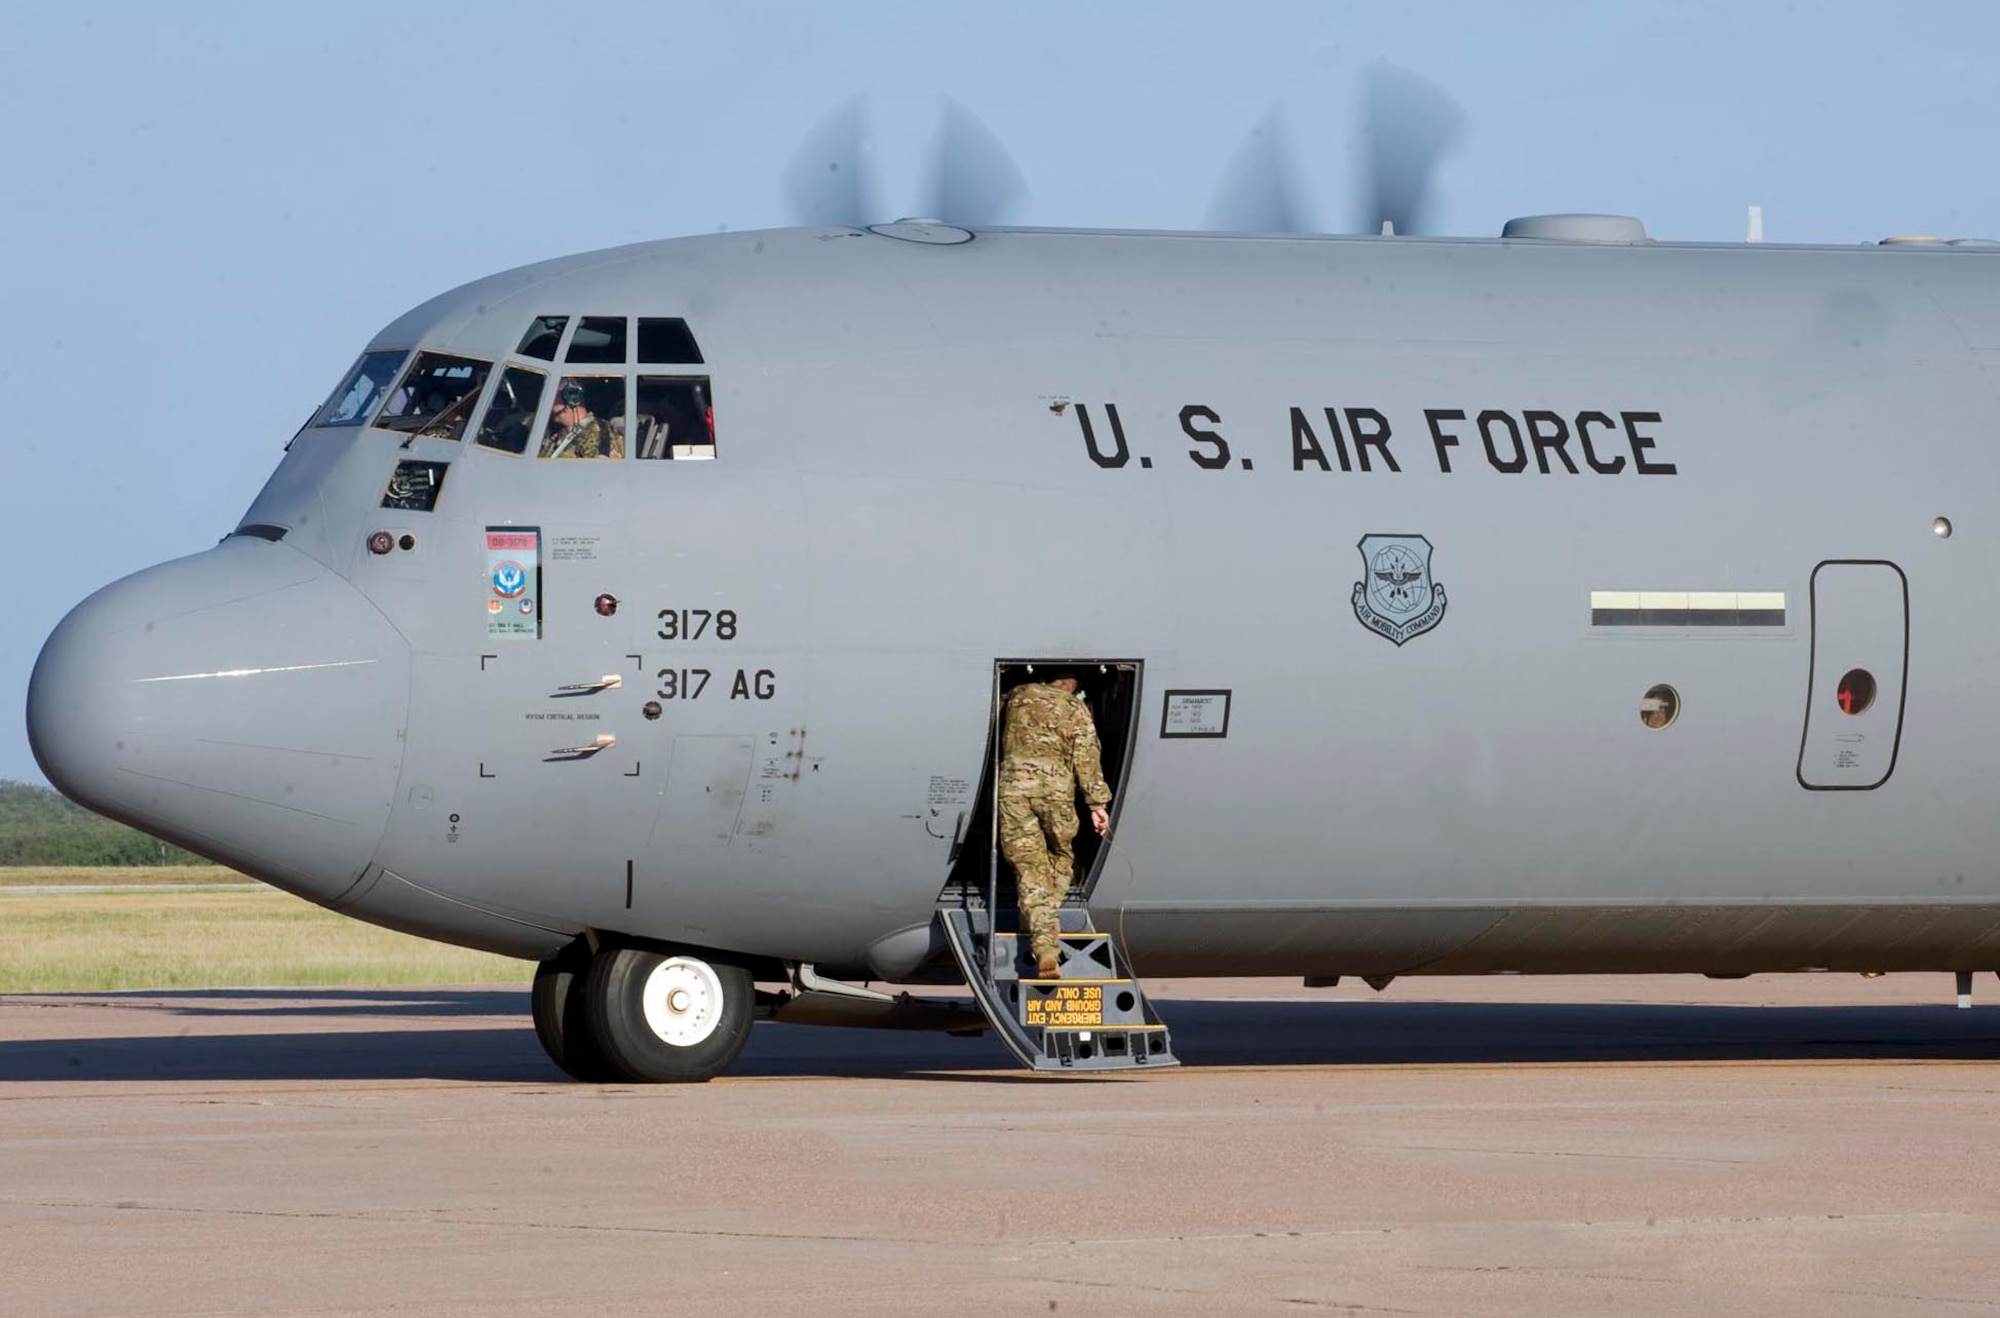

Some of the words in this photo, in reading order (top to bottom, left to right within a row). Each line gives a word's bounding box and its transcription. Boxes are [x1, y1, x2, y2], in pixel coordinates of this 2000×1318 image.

[1074, 403, 1153, 470] U.
[1178, 404, 1254, 470] S.
[1289, 407, 1402, 473] AIR
[1423, 409, 1679, 476] FORCE
[657, 609, 737, 641] 3178
[1358, 604, 1372, 621] AIR
[1370, 616, 1405, 639] MOBILITY
[1406, 604, 1440, 635] COMMAND
[657, 668, 712, 700] 317
[730, 669, 775, 700] AG
[1056, 987, 1080, 999] ONLY
[1083, 987, 1102, 999] USE
[1027, 1000, 1042, 1012] AIR
[1045, 1000, 1063, 1012] AND
[1066, 1000, 1102, 1012] GROUND
[1027, 1012, 1046, 1025] EXIT
[1049, 1012, 1102, 1025] EMERGENCY
